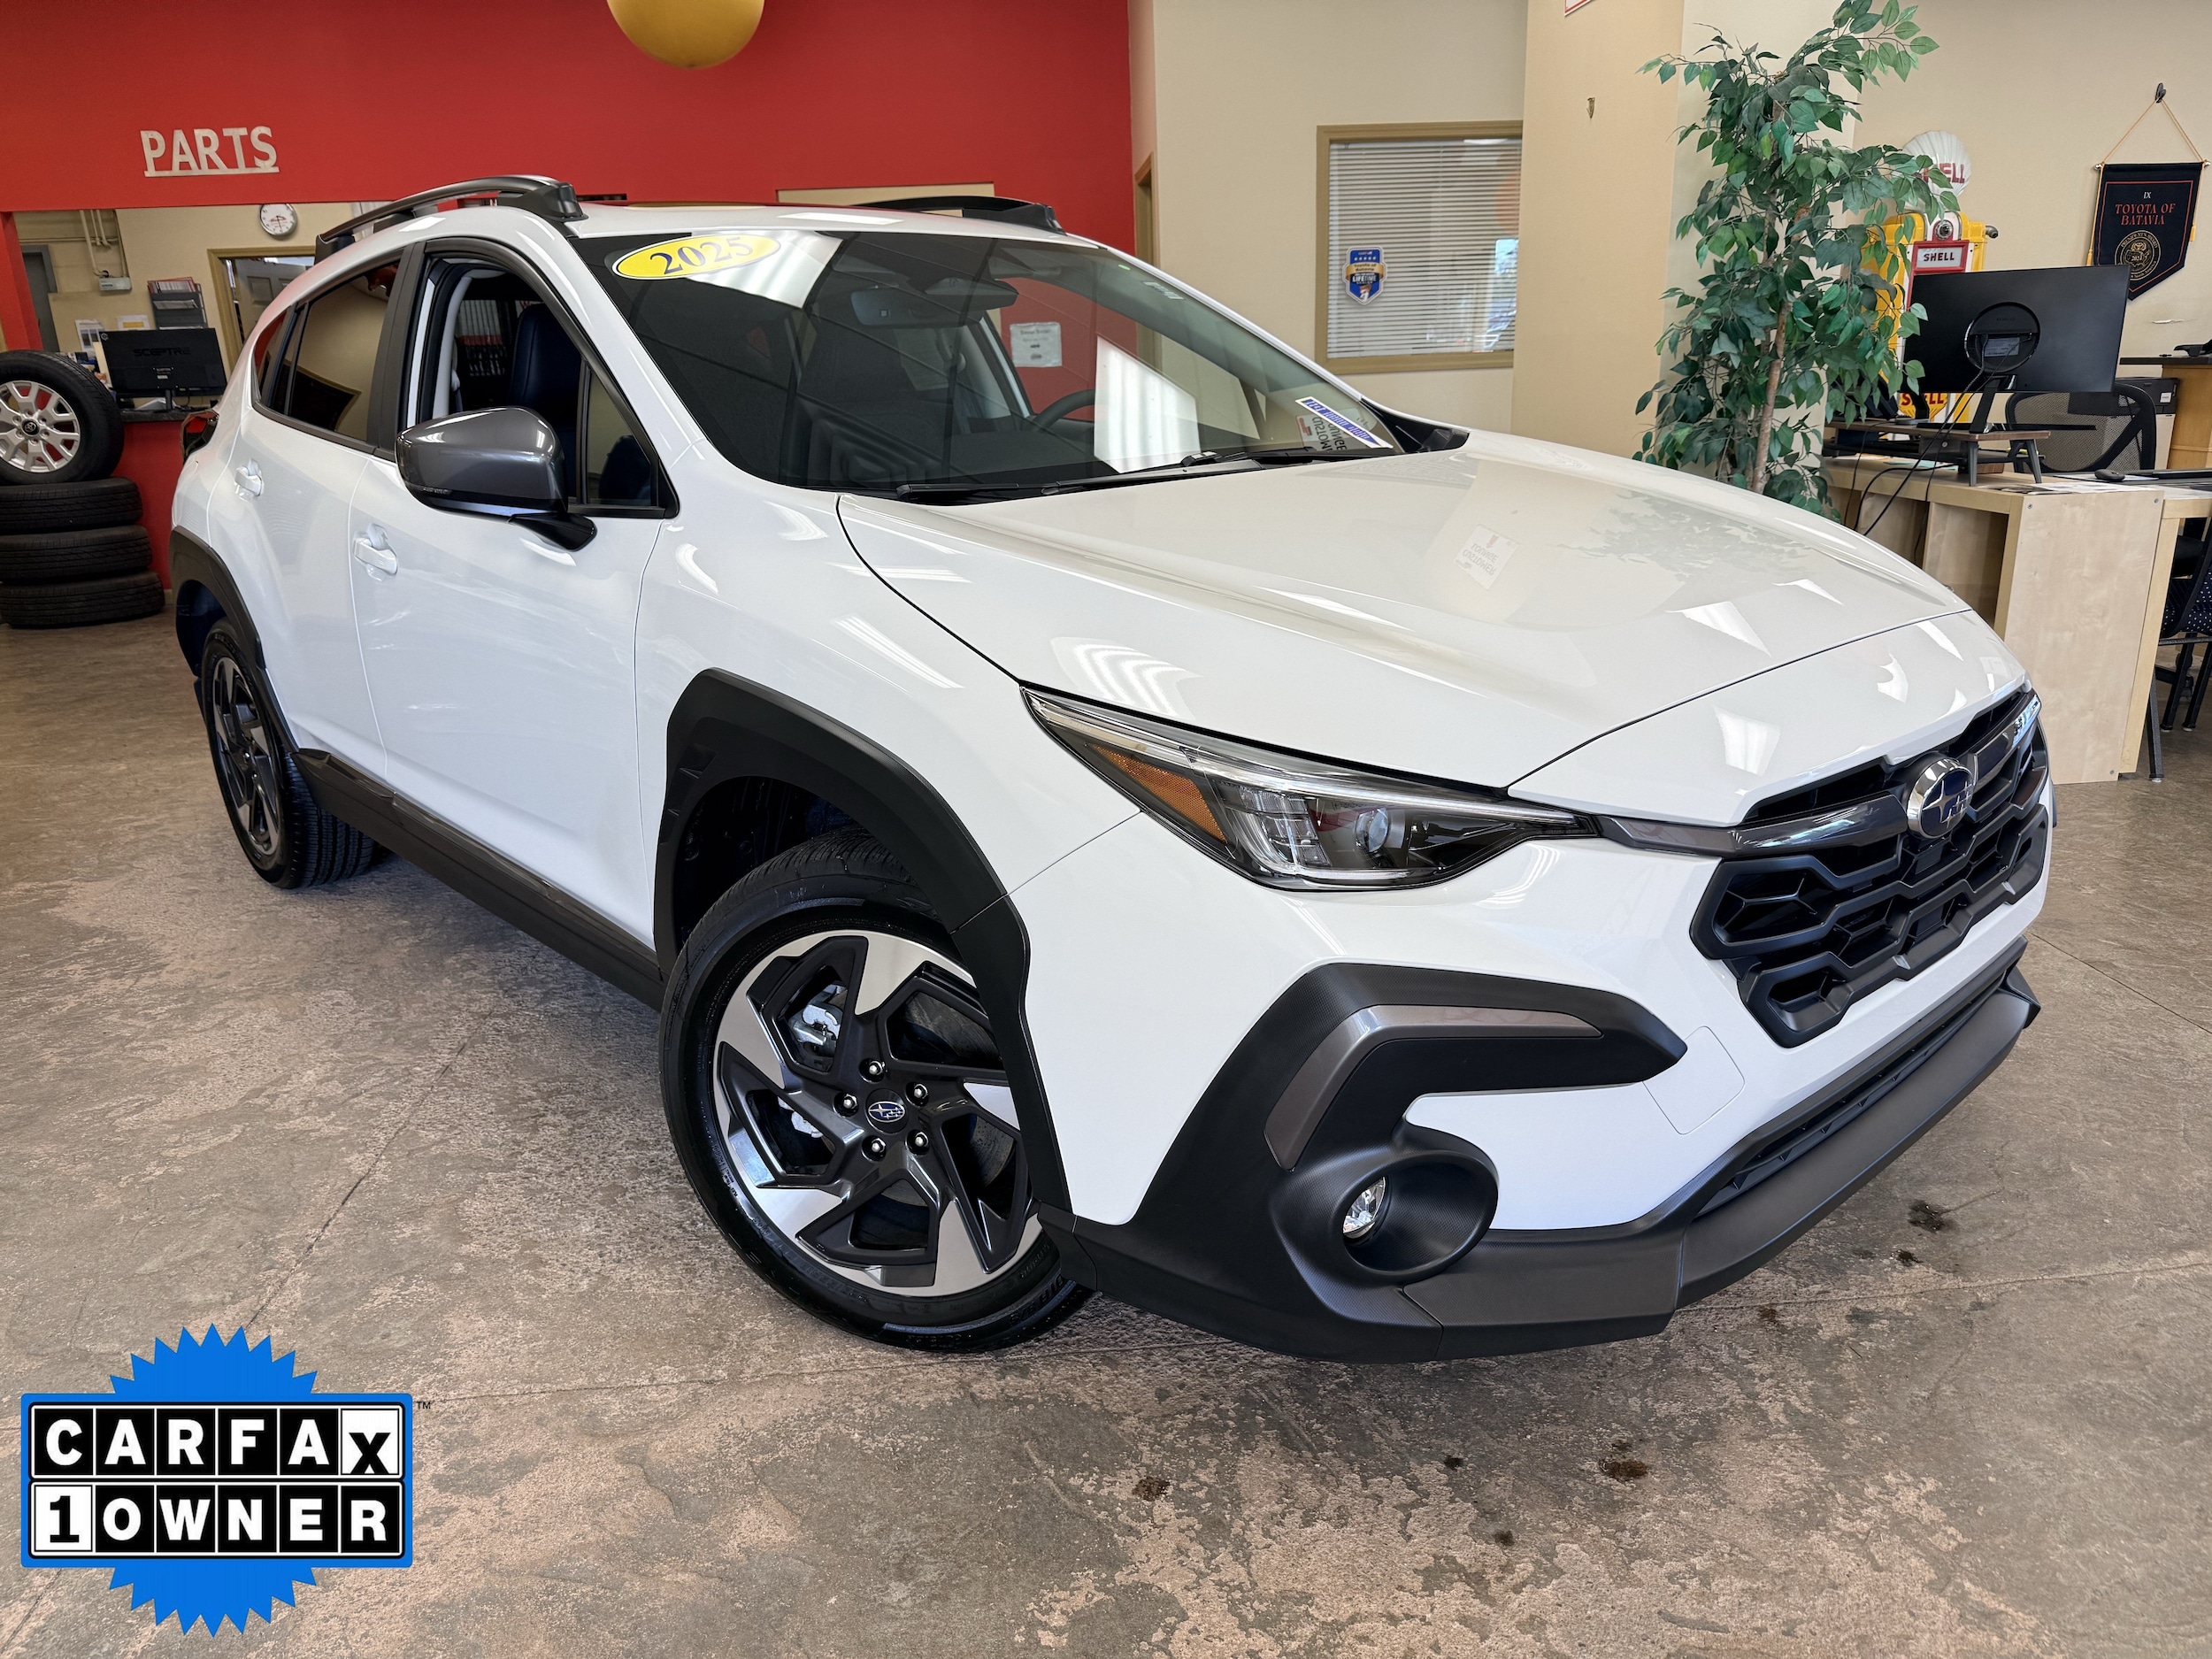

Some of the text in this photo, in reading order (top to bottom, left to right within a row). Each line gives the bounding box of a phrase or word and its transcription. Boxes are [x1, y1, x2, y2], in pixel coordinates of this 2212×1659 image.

[140, 126, 280, 176] PARTS
[2115, 203, 2176, 214] TOYOTA OF
[2121, 215, 2165, 225] BATAVIA
[649, 236, 753, 275] 2025
[1924, 252, 1955, 262] SHELL
[134, 347, 191, 357] SCEPTRE
[1901, 393, 1944, 406] SLL
